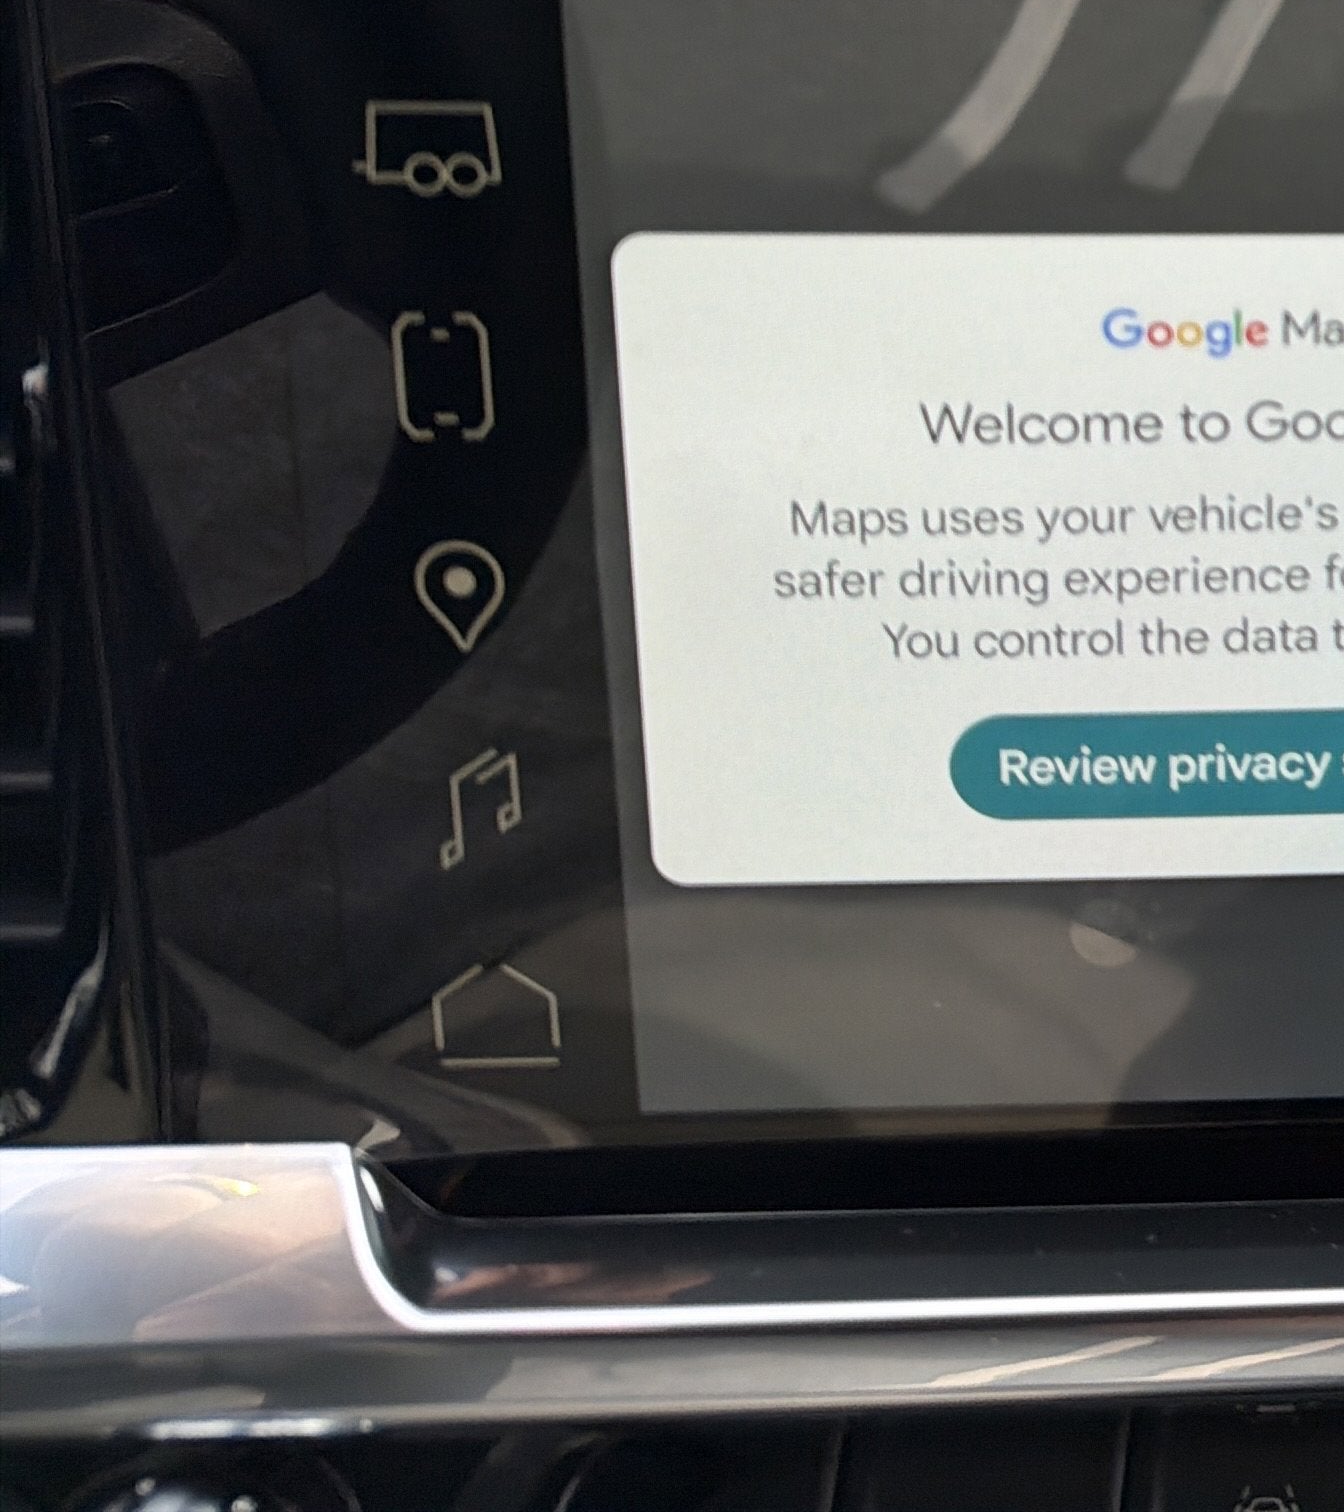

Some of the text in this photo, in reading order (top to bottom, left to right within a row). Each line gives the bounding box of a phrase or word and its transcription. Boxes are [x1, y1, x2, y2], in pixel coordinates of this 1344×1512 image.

[1102, 307, 1269, 359] Google
[919, 401, 1163, 446] Welcome
[1179, 403, 1231, 444] to
[789, 499, 909, 545] Maps
[921, 507, 1024, 537] uses
[1036, 504, 1135, 544] your
[1149, 493, 1339, 534] vehicle's
[773, 559, 885, 599] safer
[898, 559, 1049, 606] driving
[1064, 555, 1311, 604] experience
[882, 621, 959, 659] You
[973, 618, 1124, 658] control
[1138, 617, 1209, 656] the
[1222, 616, 1319, 654] data
[999, 744, 1157, 787] Review
[1168, 743, 1330, 791] privacy
